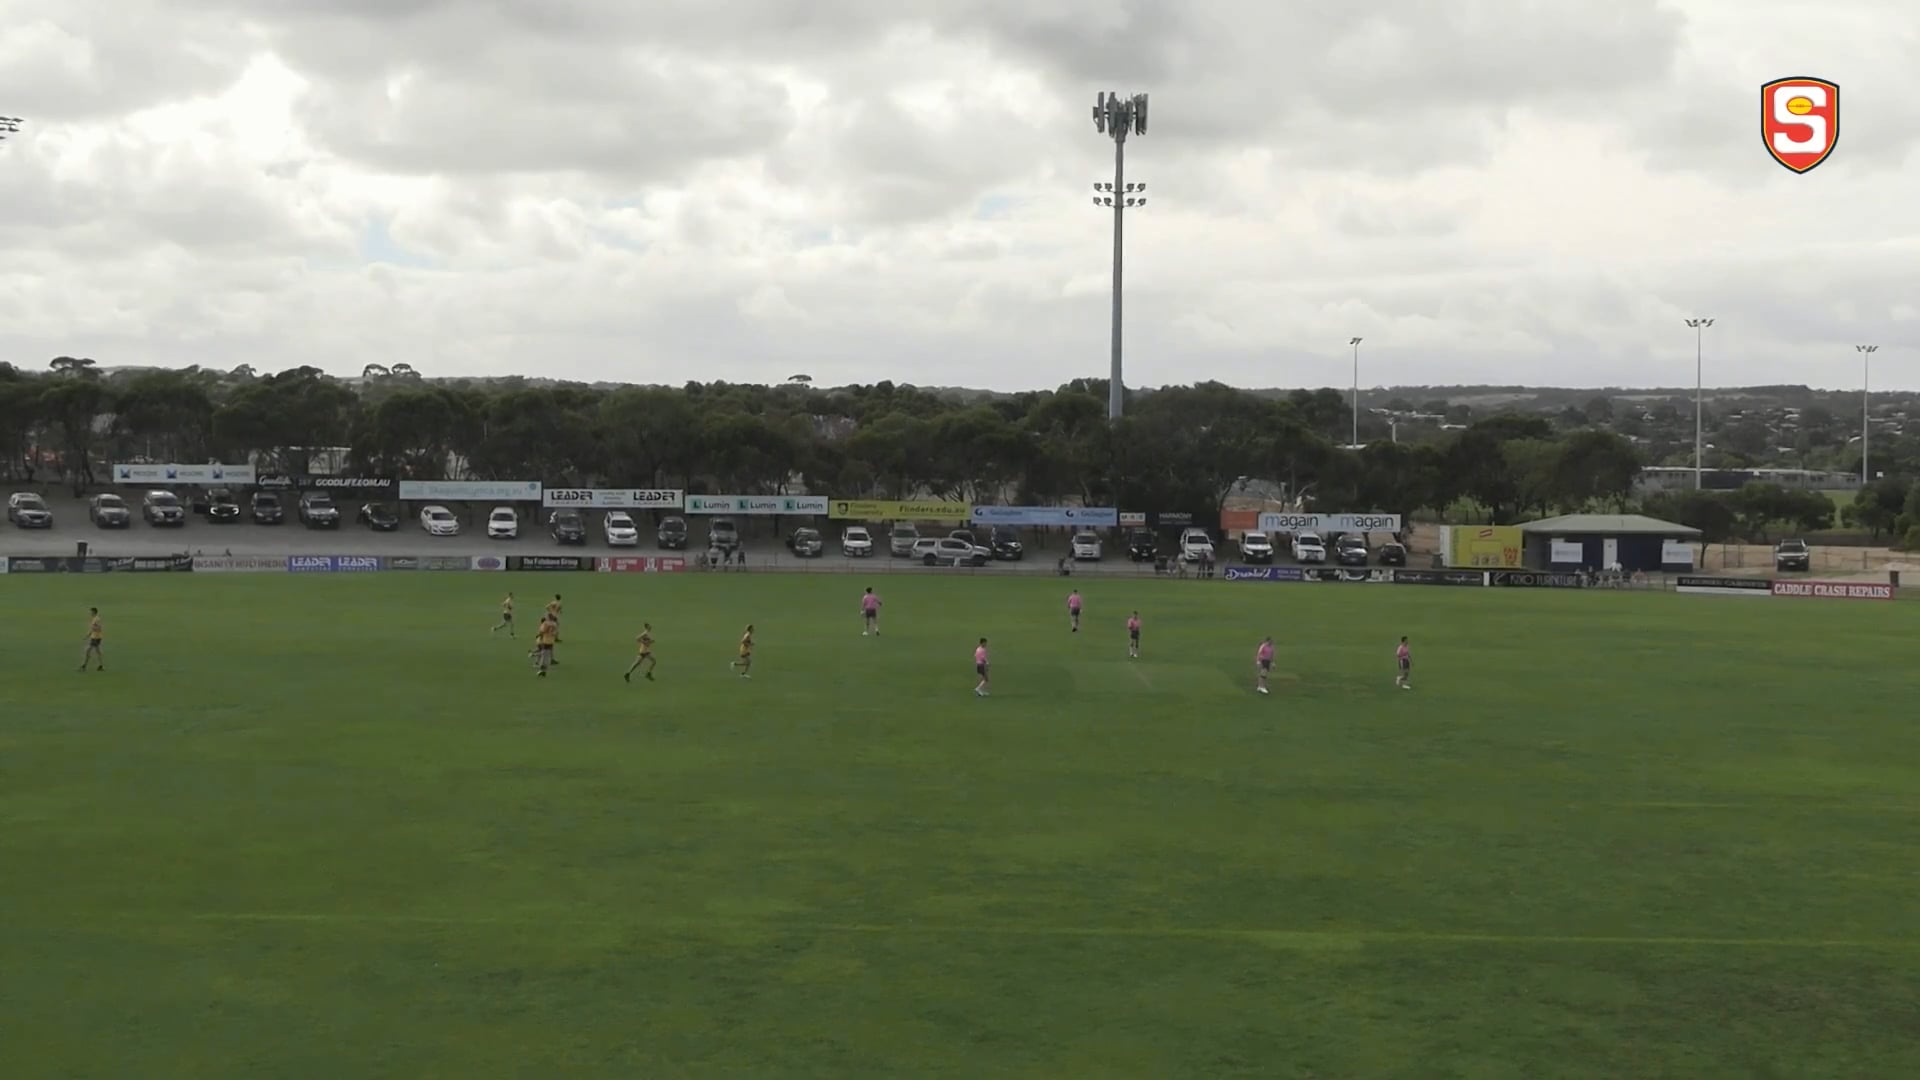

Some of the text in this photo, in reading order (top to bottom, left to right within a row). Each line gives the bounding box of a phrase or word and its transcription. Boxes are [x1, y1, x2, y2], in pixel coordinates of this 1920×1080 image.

[551, 491, 593, 501] LEADER
[633, 491, 676, 501] LEADER
[703, 500, 730, 509] Lumin
[750, 501, 777, 510] Lumin
[796, 502, 824, 511] Lumin
[1159, 512, 1192, 520] HARMONY
[1265, 515, 1319, 529] magain
[1340, 516, 1394, 530] magain
[292, 557, 331, 567] LEADER
[338, 557, 377, 567] LEADER
[1774, 583, 1891, 598] CADDLE CRASH REPAIRS
